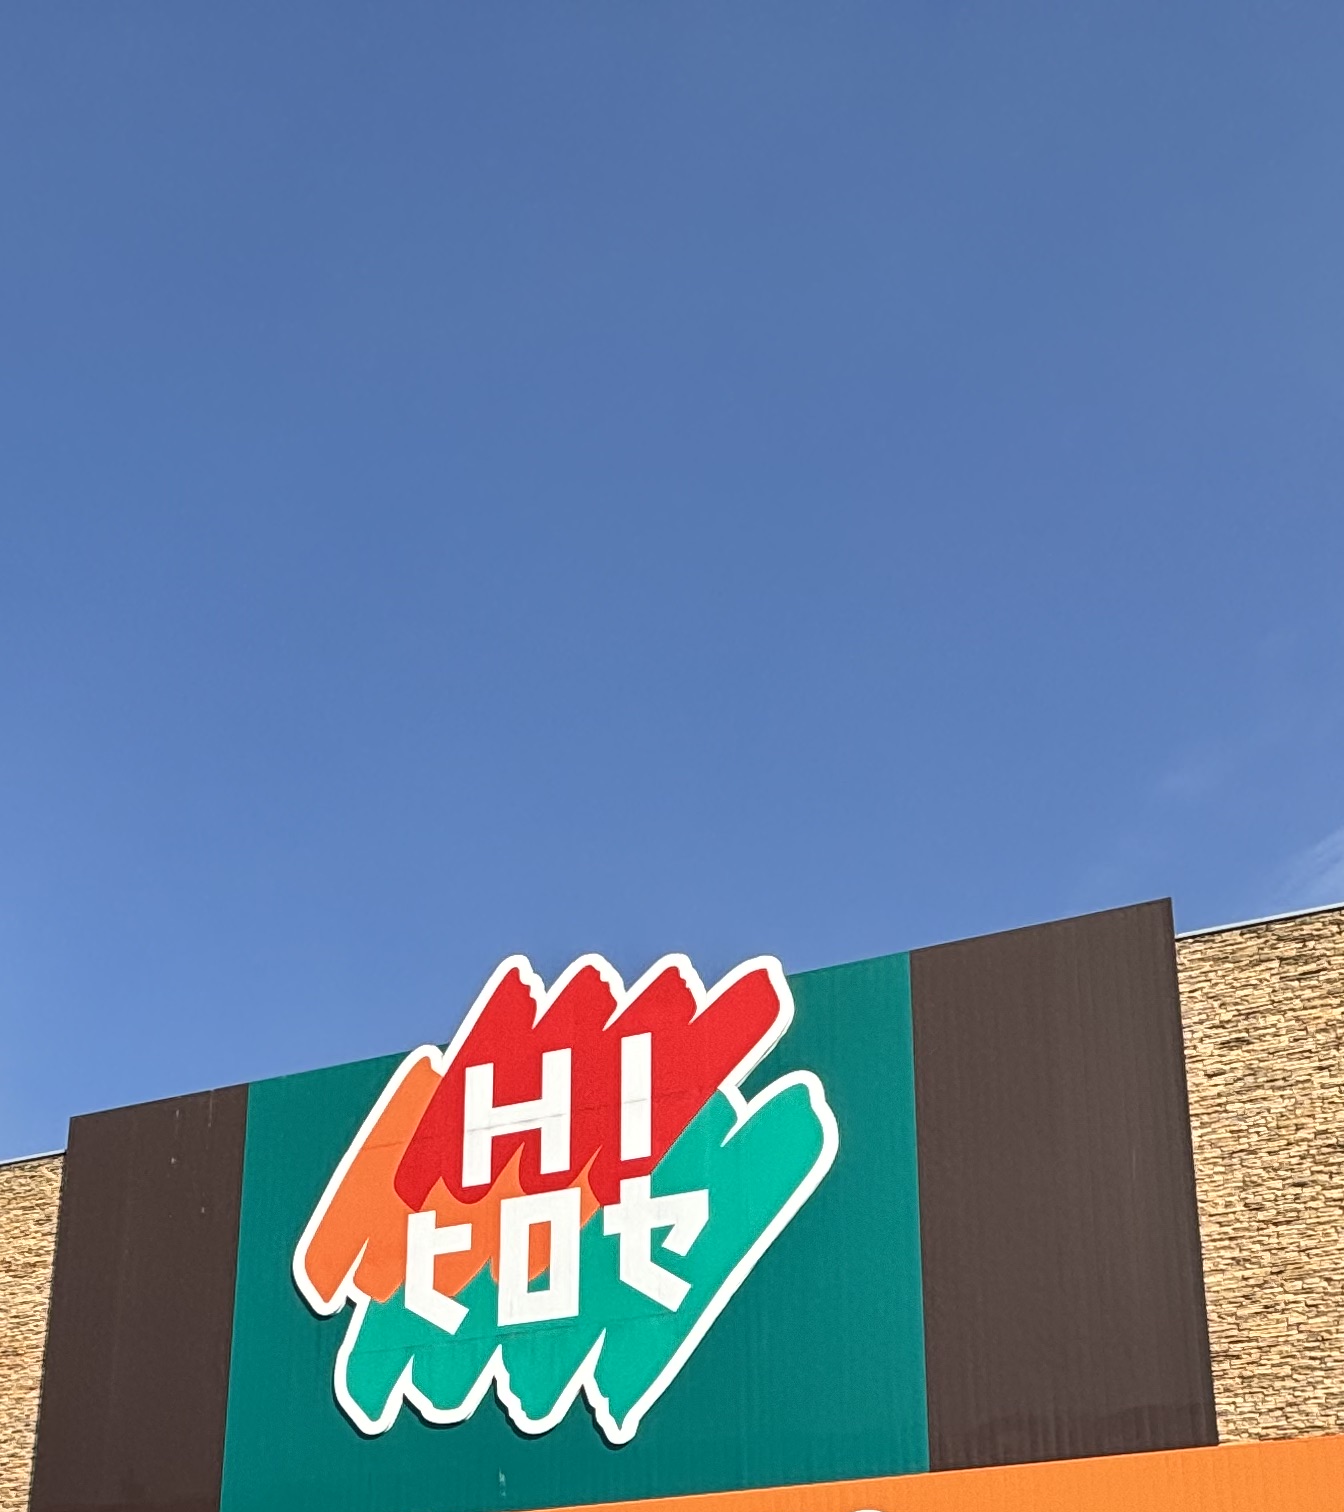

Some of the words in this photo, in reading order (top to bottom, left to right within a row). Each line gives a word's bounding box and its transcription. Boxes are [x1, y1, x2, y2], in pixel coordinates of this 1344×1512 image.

[462, 1030, 654, 1190] HI
[404, 1173, 709, 1335] ヒロセ
